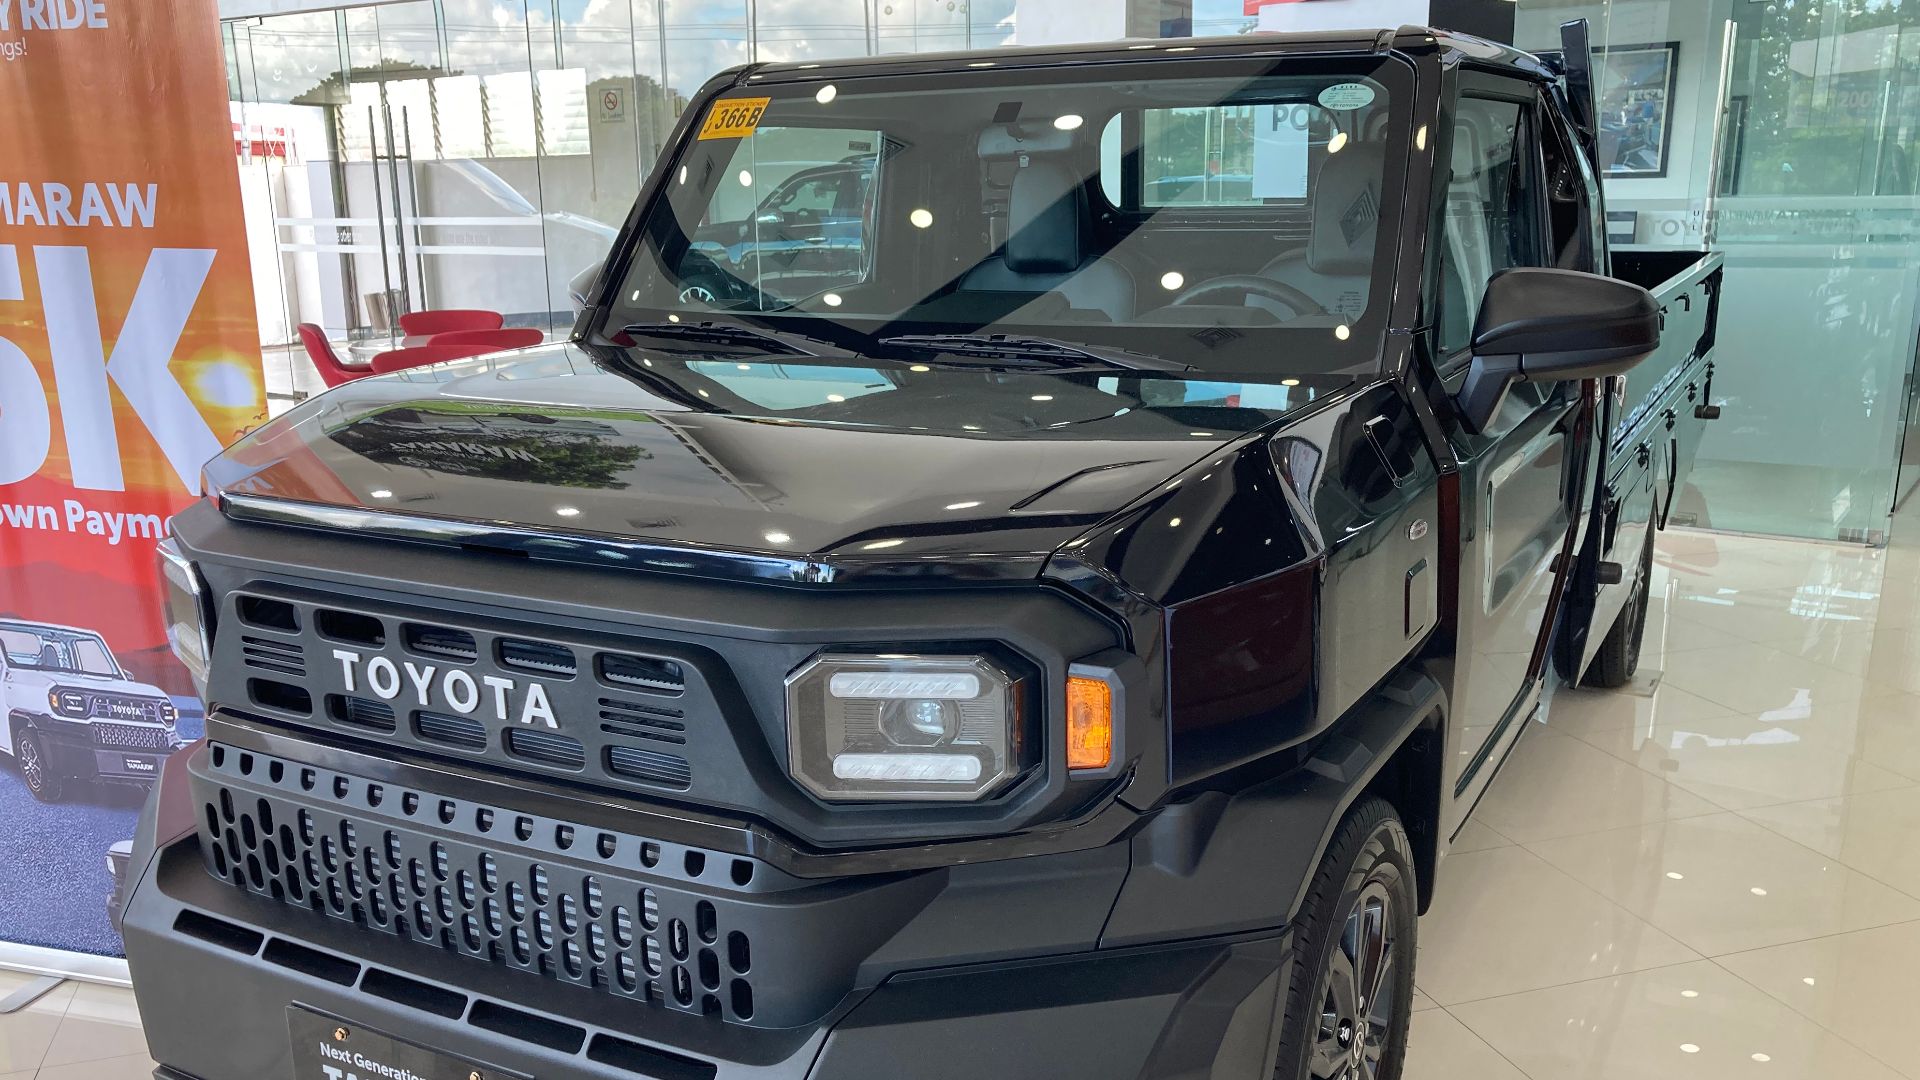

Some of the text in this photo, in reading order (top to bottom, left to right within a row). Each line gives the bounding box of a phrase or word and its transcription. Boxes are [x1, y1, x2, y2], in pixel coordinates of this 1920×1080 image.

[20, 0, 108, 30] RIDE
[332, 649, 559, 729] TOYOTA
[112, 704, 142, 716] TOYOTA
[319, 1041, 352, 1065] Next
